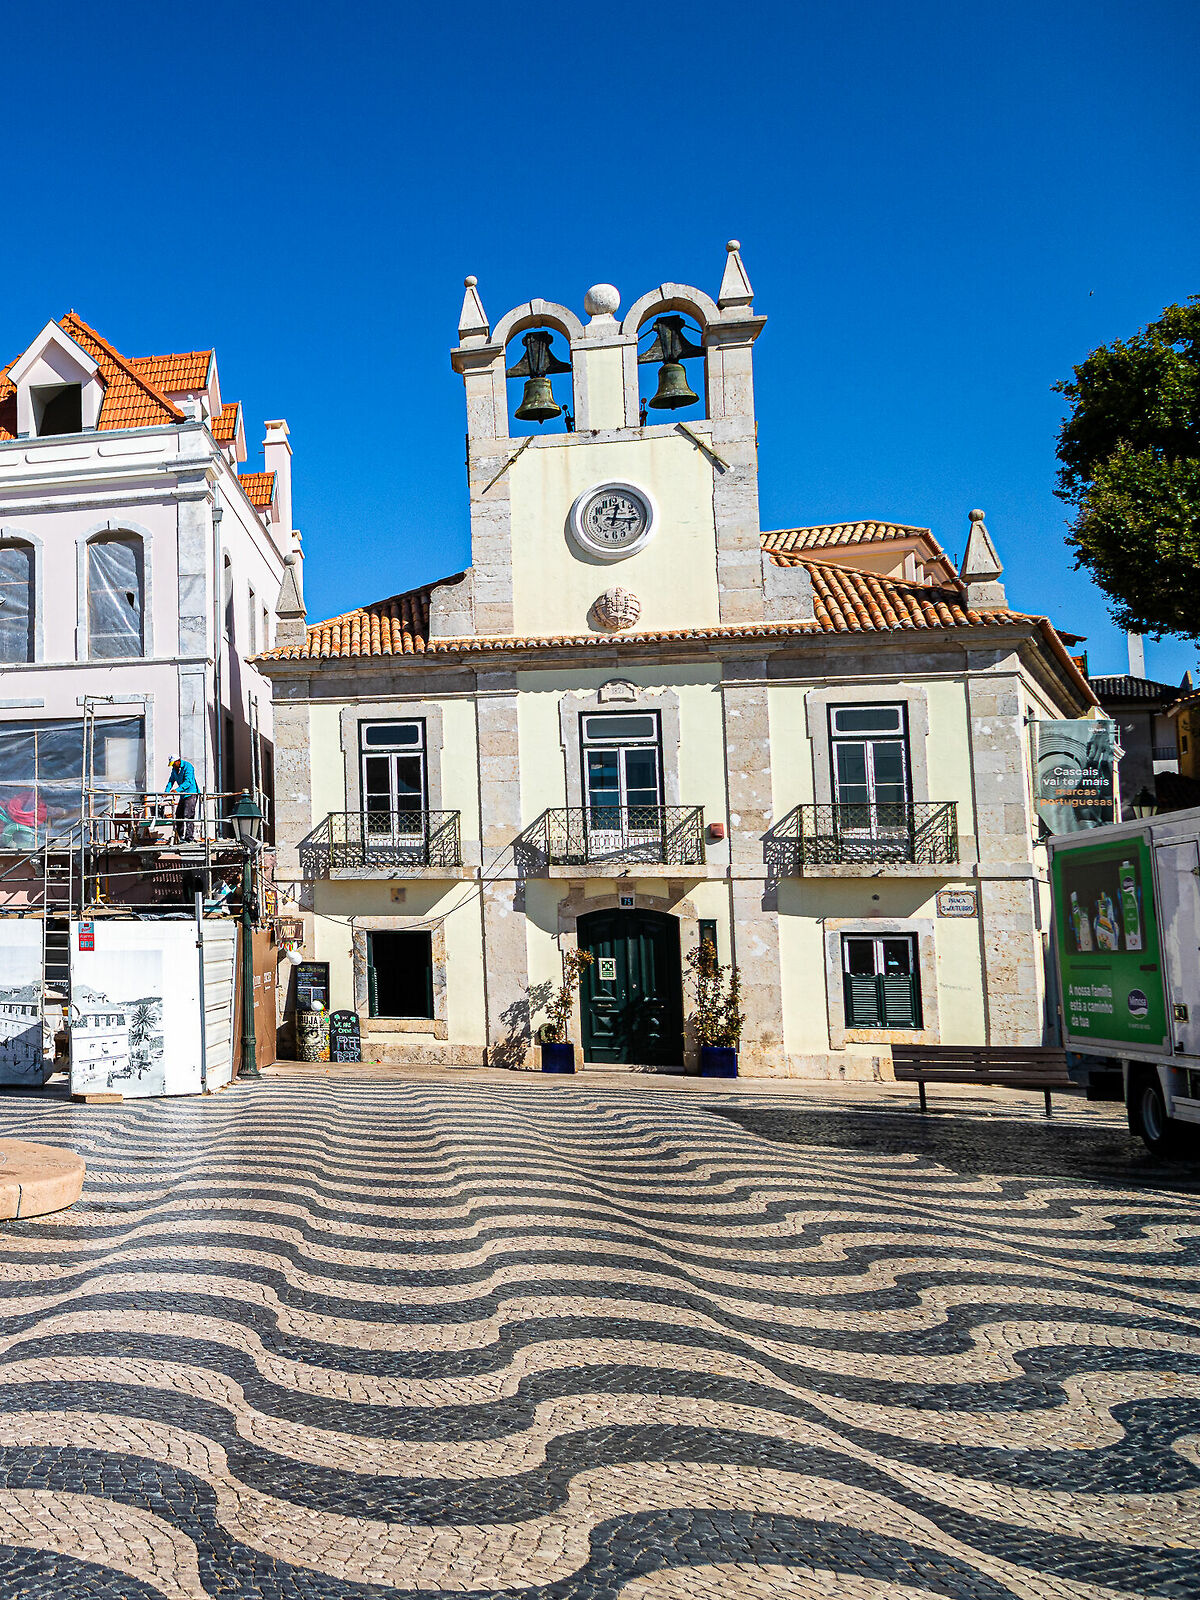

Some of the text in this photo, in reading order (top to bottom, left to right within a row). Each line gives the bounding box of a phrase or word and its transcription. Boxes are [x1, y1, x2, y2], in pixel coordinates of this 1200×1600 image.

[1053, 767, 1099, 776] Cascais
[1042, 778, 1109, 786] vai ter mais
[1040, 798, 1113, 807] portuguesas
[623, 898, 632, 906] 75
